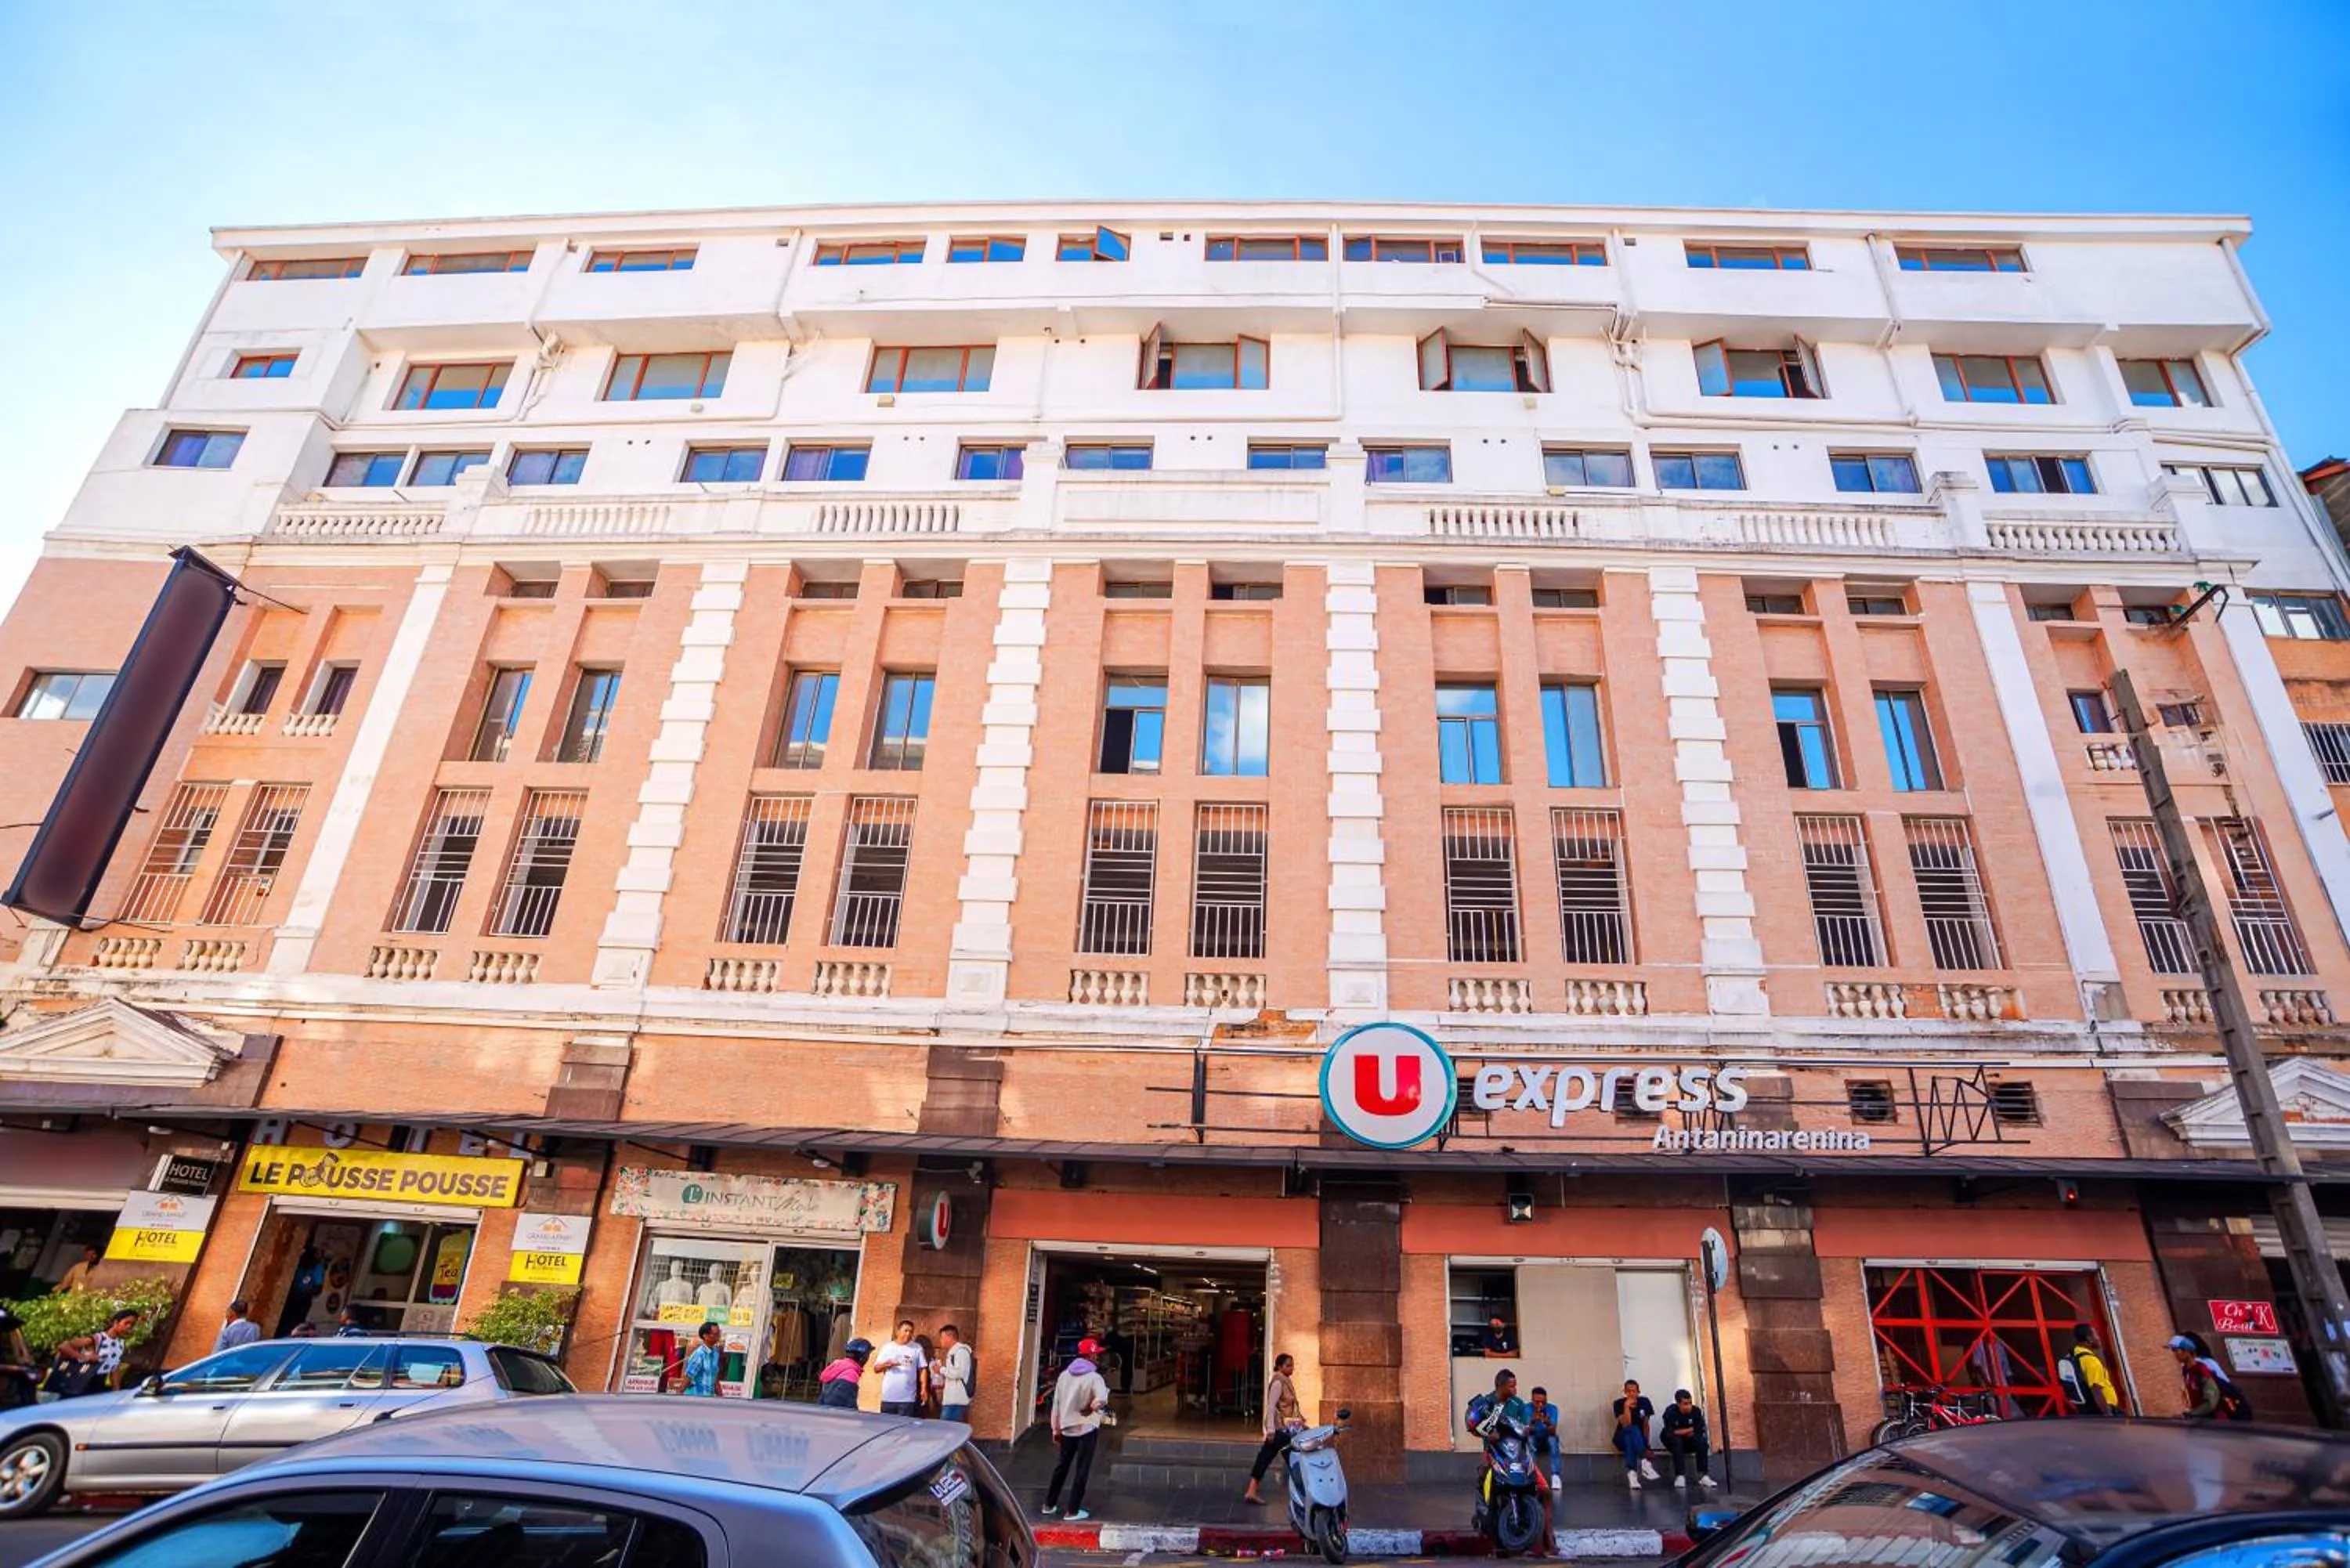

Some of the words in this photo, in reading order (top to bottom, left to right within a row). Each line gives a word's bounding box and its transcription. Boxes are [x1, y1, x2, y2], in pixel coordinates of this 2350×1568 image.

[1354, 1054, 1422, 1116] U
[1473, 1065, 1748, 1128] express
[1653, 1124, 1870, 1151] Antaninarenina
[168, 1163, 208, 1180] HOTEL
[249, 1162, 283, 1185] LE
[398, 1169, 509, 1199] POUSSE
[135, 1230, 177, 1247] HOTEL
[525, 1253, 567, 1270] HOTEL
